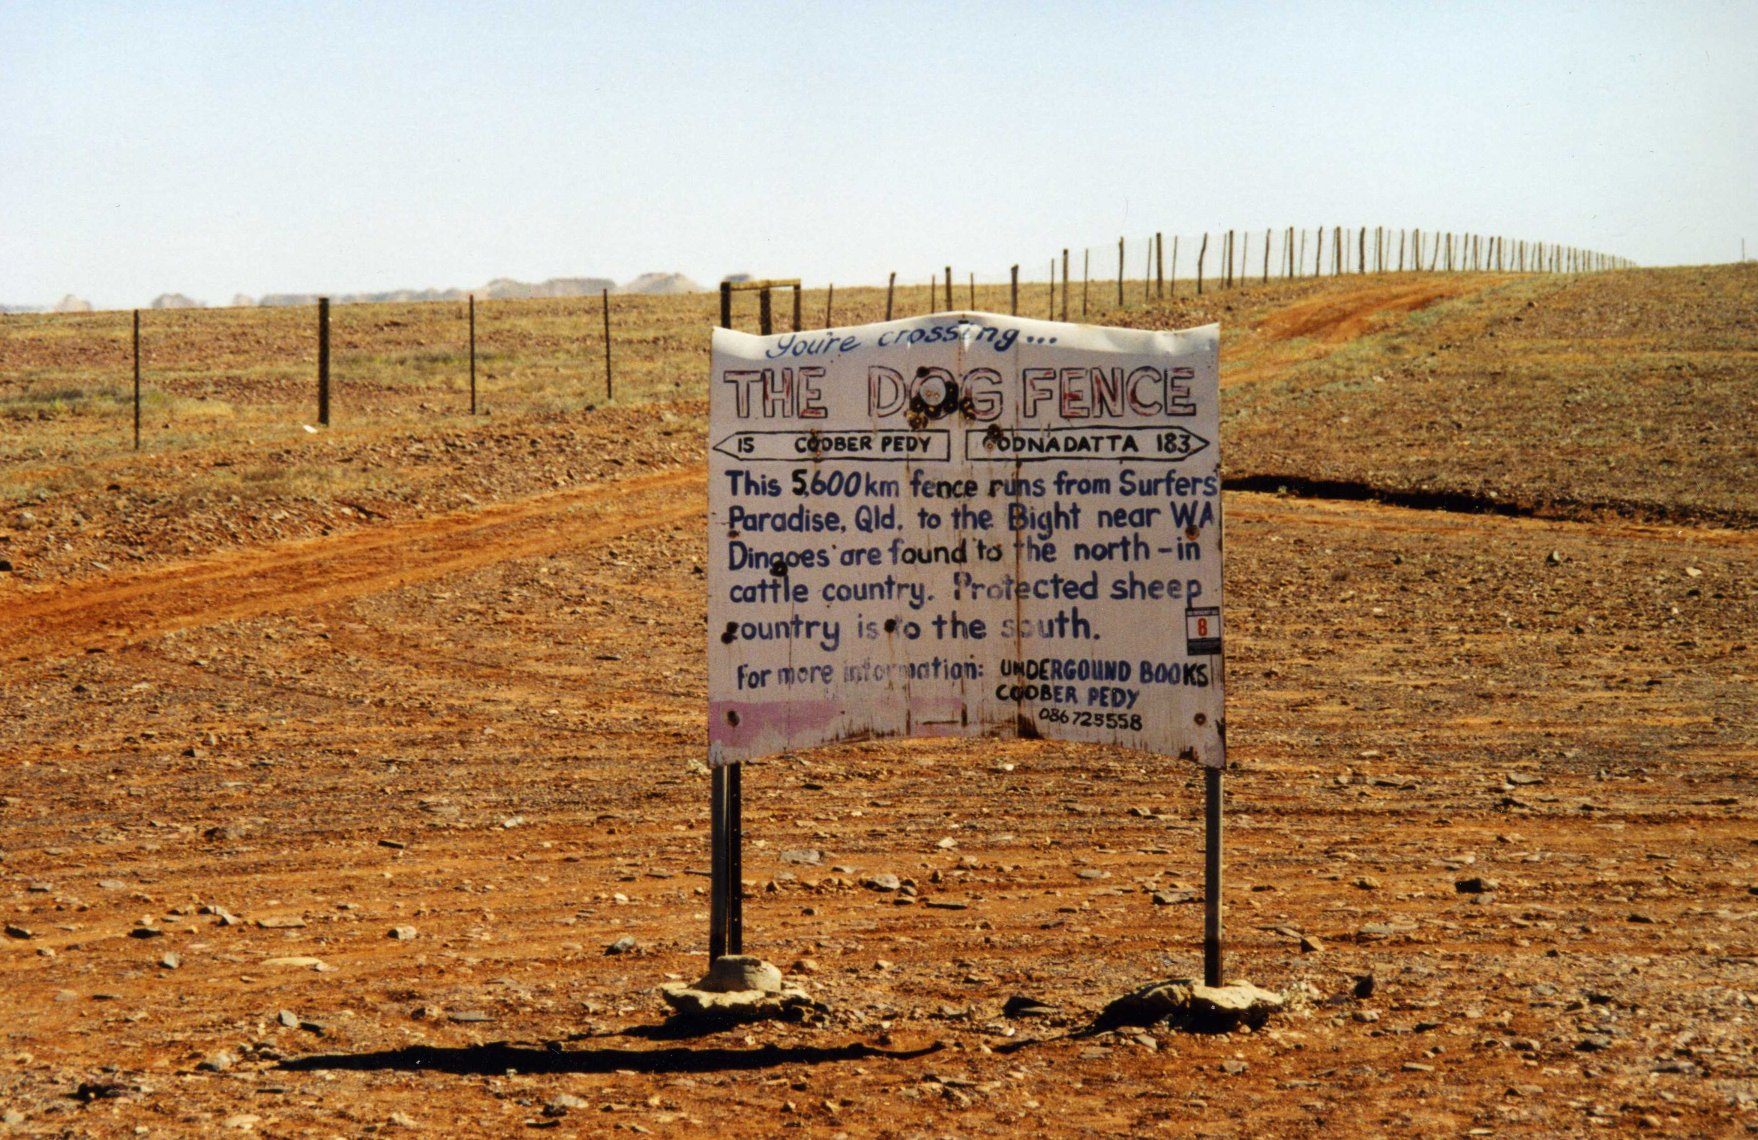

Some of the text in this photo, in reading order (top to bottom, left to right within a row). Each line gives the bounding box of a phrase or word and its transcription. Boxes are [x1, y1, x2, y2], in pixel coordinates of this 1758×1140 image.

[723, 365, 1197, 422] THE DOG FENCE
[738, 436, 931, 453] 15 COOBER PEDY
[982, 434, 1191, 454] OODNADATTA 183
[725, 469, 782, 497] This
[909, 469, 978, 498] fence
[988, 478, 1046, 497] runs
[1053, 471, 1110, 496] from
[1119, 469, 1218, 496] Surfers
[728, 501, 1214, 540] Paradise, Qld. to the Bight near WA
[728, 541, 830, 574] Dingoes
[840, 547, 882, 566] are
[888, 537, 967, 566] found
[977, 538, 1003, 562] to
[729, 570, 1202, 609] cattle country. Protected sheep
[727, 613, 840, 652] ountry
[858, 613, 880, 641] is
[931, 609, 987, 640] the
[1000, 606, 1100, 640] south.
[1197, 617, 1207, 637] 8
[778, 664, 833, 685] more
[1000, 659, 1131, 682] UNDERGOUND
[1139, 660, 1209, 688] BOOKS
[995, 684, 1140, 709] COOBER PEDY
